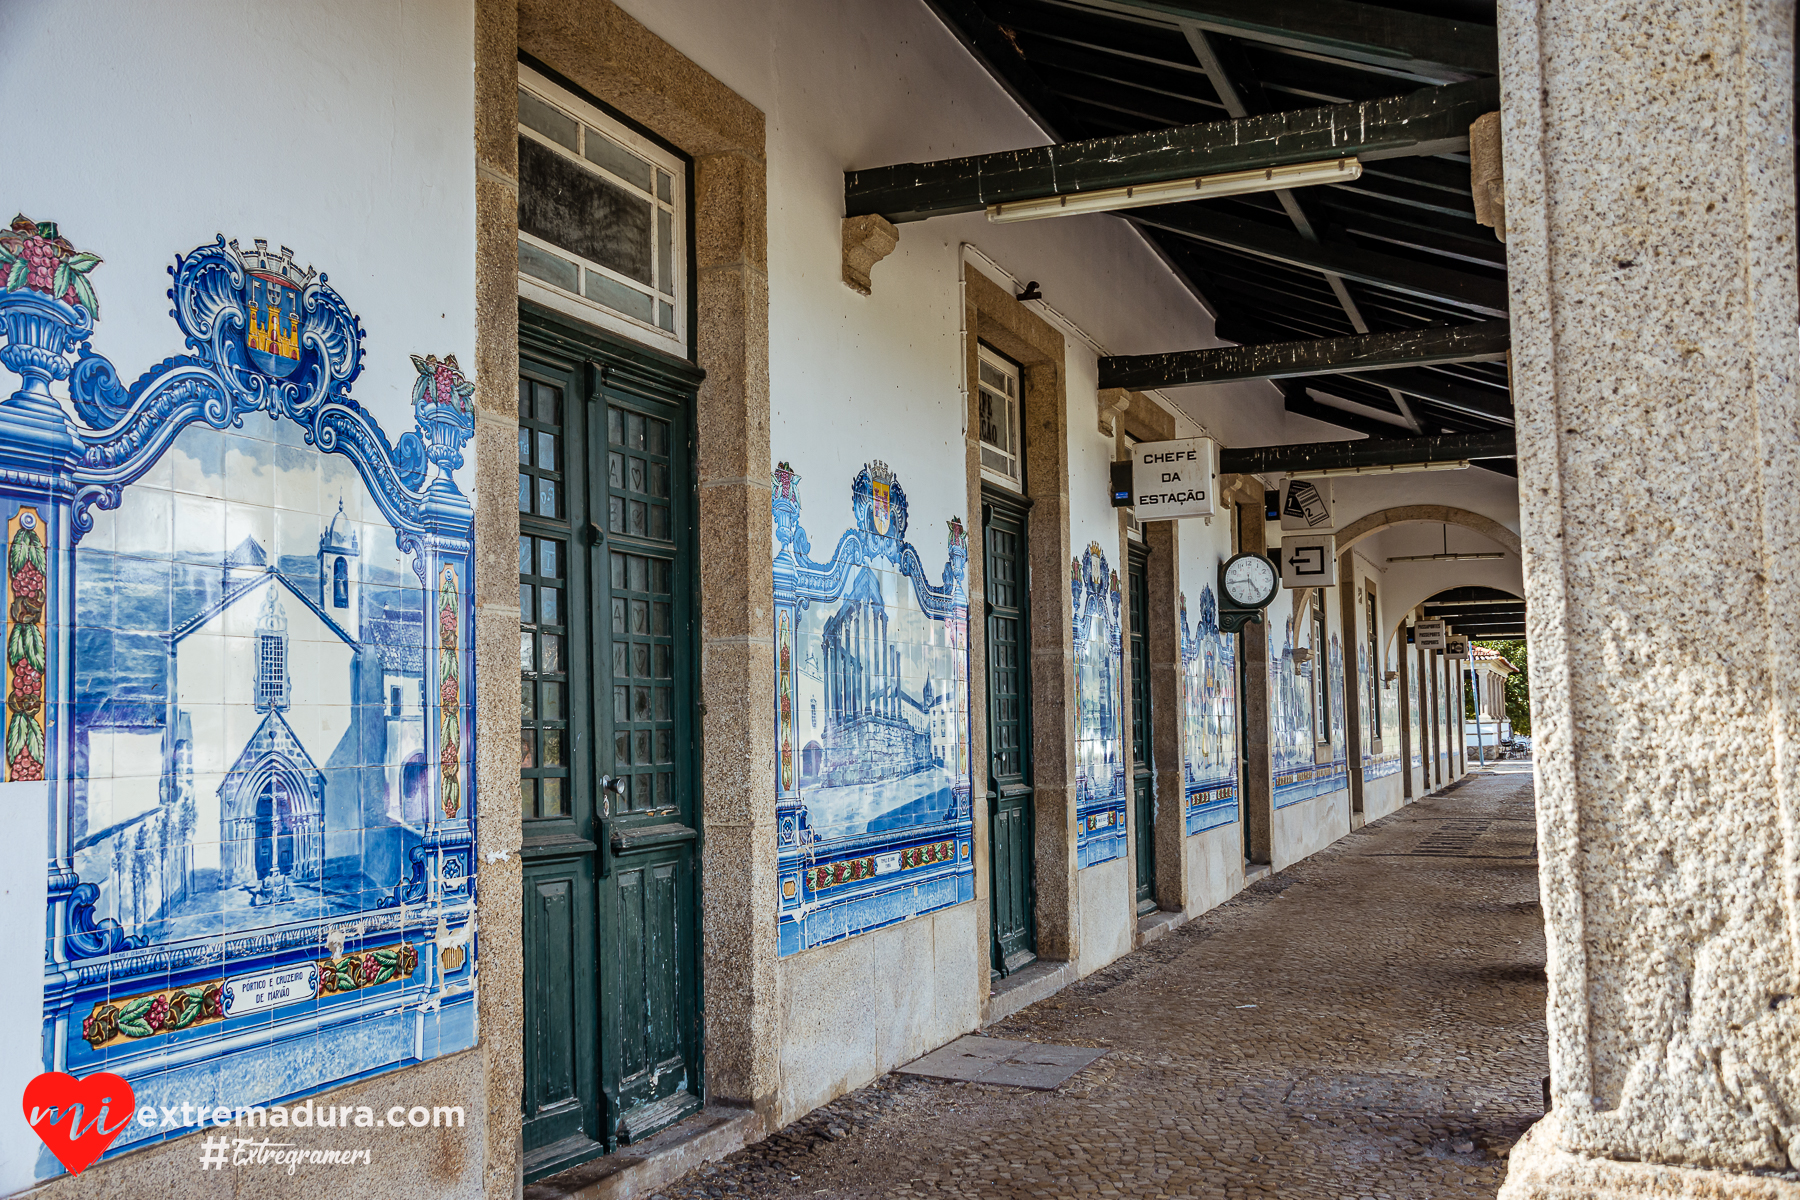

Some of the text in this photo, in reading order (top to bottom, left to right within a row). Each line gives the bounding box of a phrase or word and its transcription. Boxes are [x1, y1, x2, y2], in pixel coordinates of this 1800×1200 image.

[1143, 450, 1197, 465] CHEFE
[1161, 472, 1181, 483] DA
[1139, 489, 1205, 506] ESTAÇÃO
[1288, 497, 1293, 507] 1
[1305, 507, 1313, 518] 2
[242, 971, 304, 993] PÓRTICO E CRUZEIRO
[255, 985, 290, 1004] DE MARVÃO
